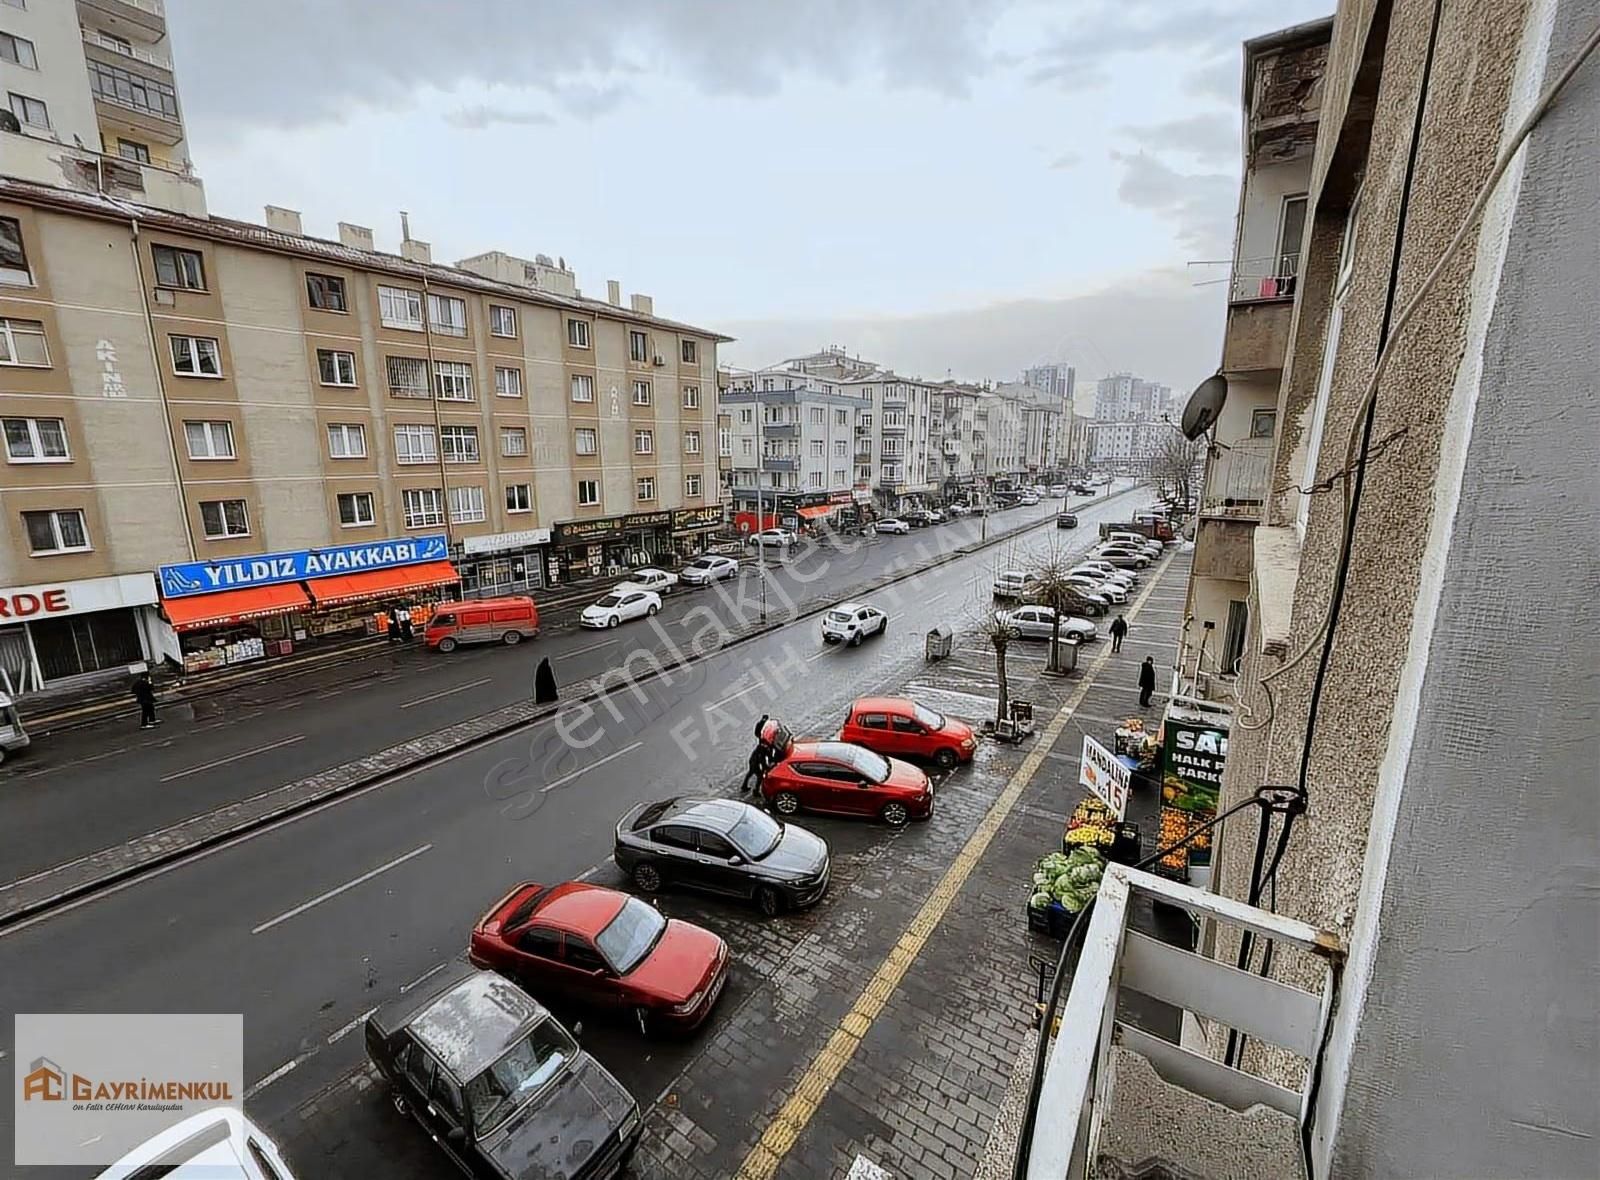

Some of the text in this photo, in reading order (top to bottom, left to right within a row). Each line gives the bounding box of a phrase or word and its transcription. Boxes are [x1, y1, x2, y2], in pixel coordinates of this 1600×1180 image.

[204, 543, 417, 586] YILDIZ AYAKKABI
[1171, 752, 1212, 769] HALK
[1106, 779, 1122, 812] 15
